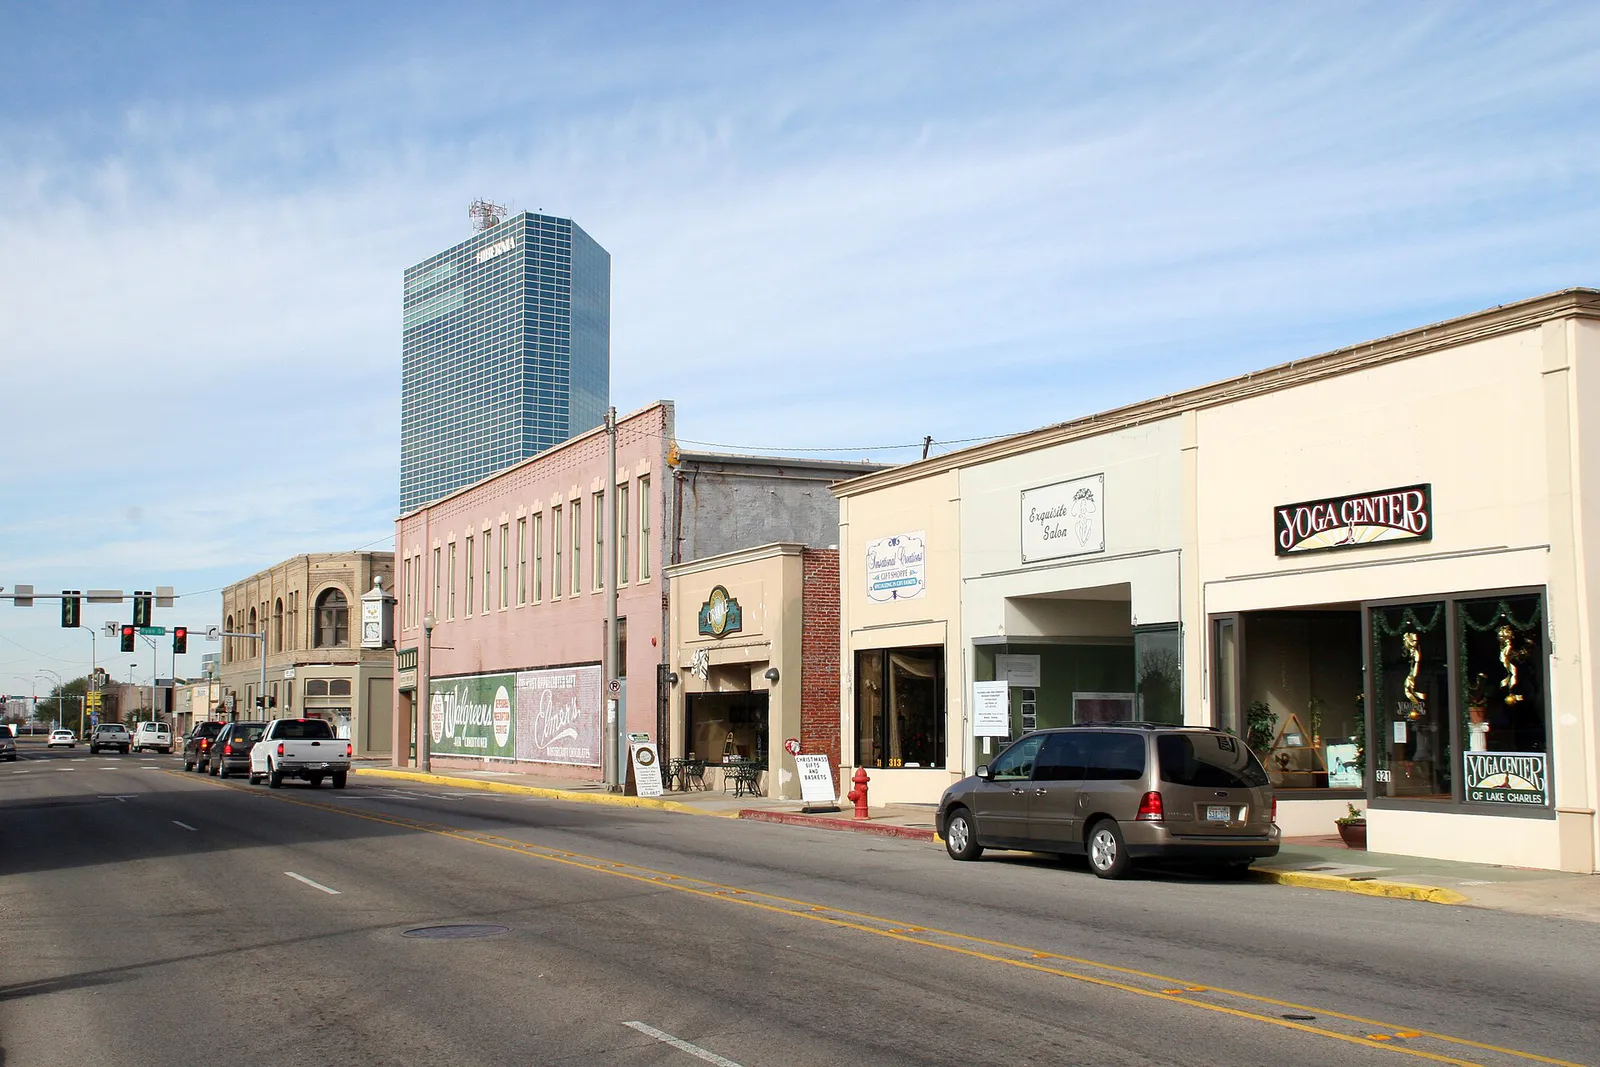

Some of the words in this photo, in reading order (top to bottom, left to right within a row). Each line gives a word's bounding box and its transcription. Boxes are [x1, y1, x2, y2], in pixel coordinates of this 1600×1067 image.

[1029, 504, 1068, 526] Exquisite
[1279, 503, 1339, 548] YOGA
[1341, 490, 1427, 533] CENTER
[1043, 522, 1068, 541] Salon
[707, 598, 730, 624] CREOLE
[444, 684, 492, 740] Walgreens
[888, 758, 902, 767] 313
[1467, 755, 1499, 788] YOGA
[1500, 756, 1545, 791] CENTER
[1376, 771, 1390, 782] 321
[1472, 791, 1484, 800] OF
[1486, 792, 1505, 802] LAKE
[1507, 793, 1542, 804] CHARLES
